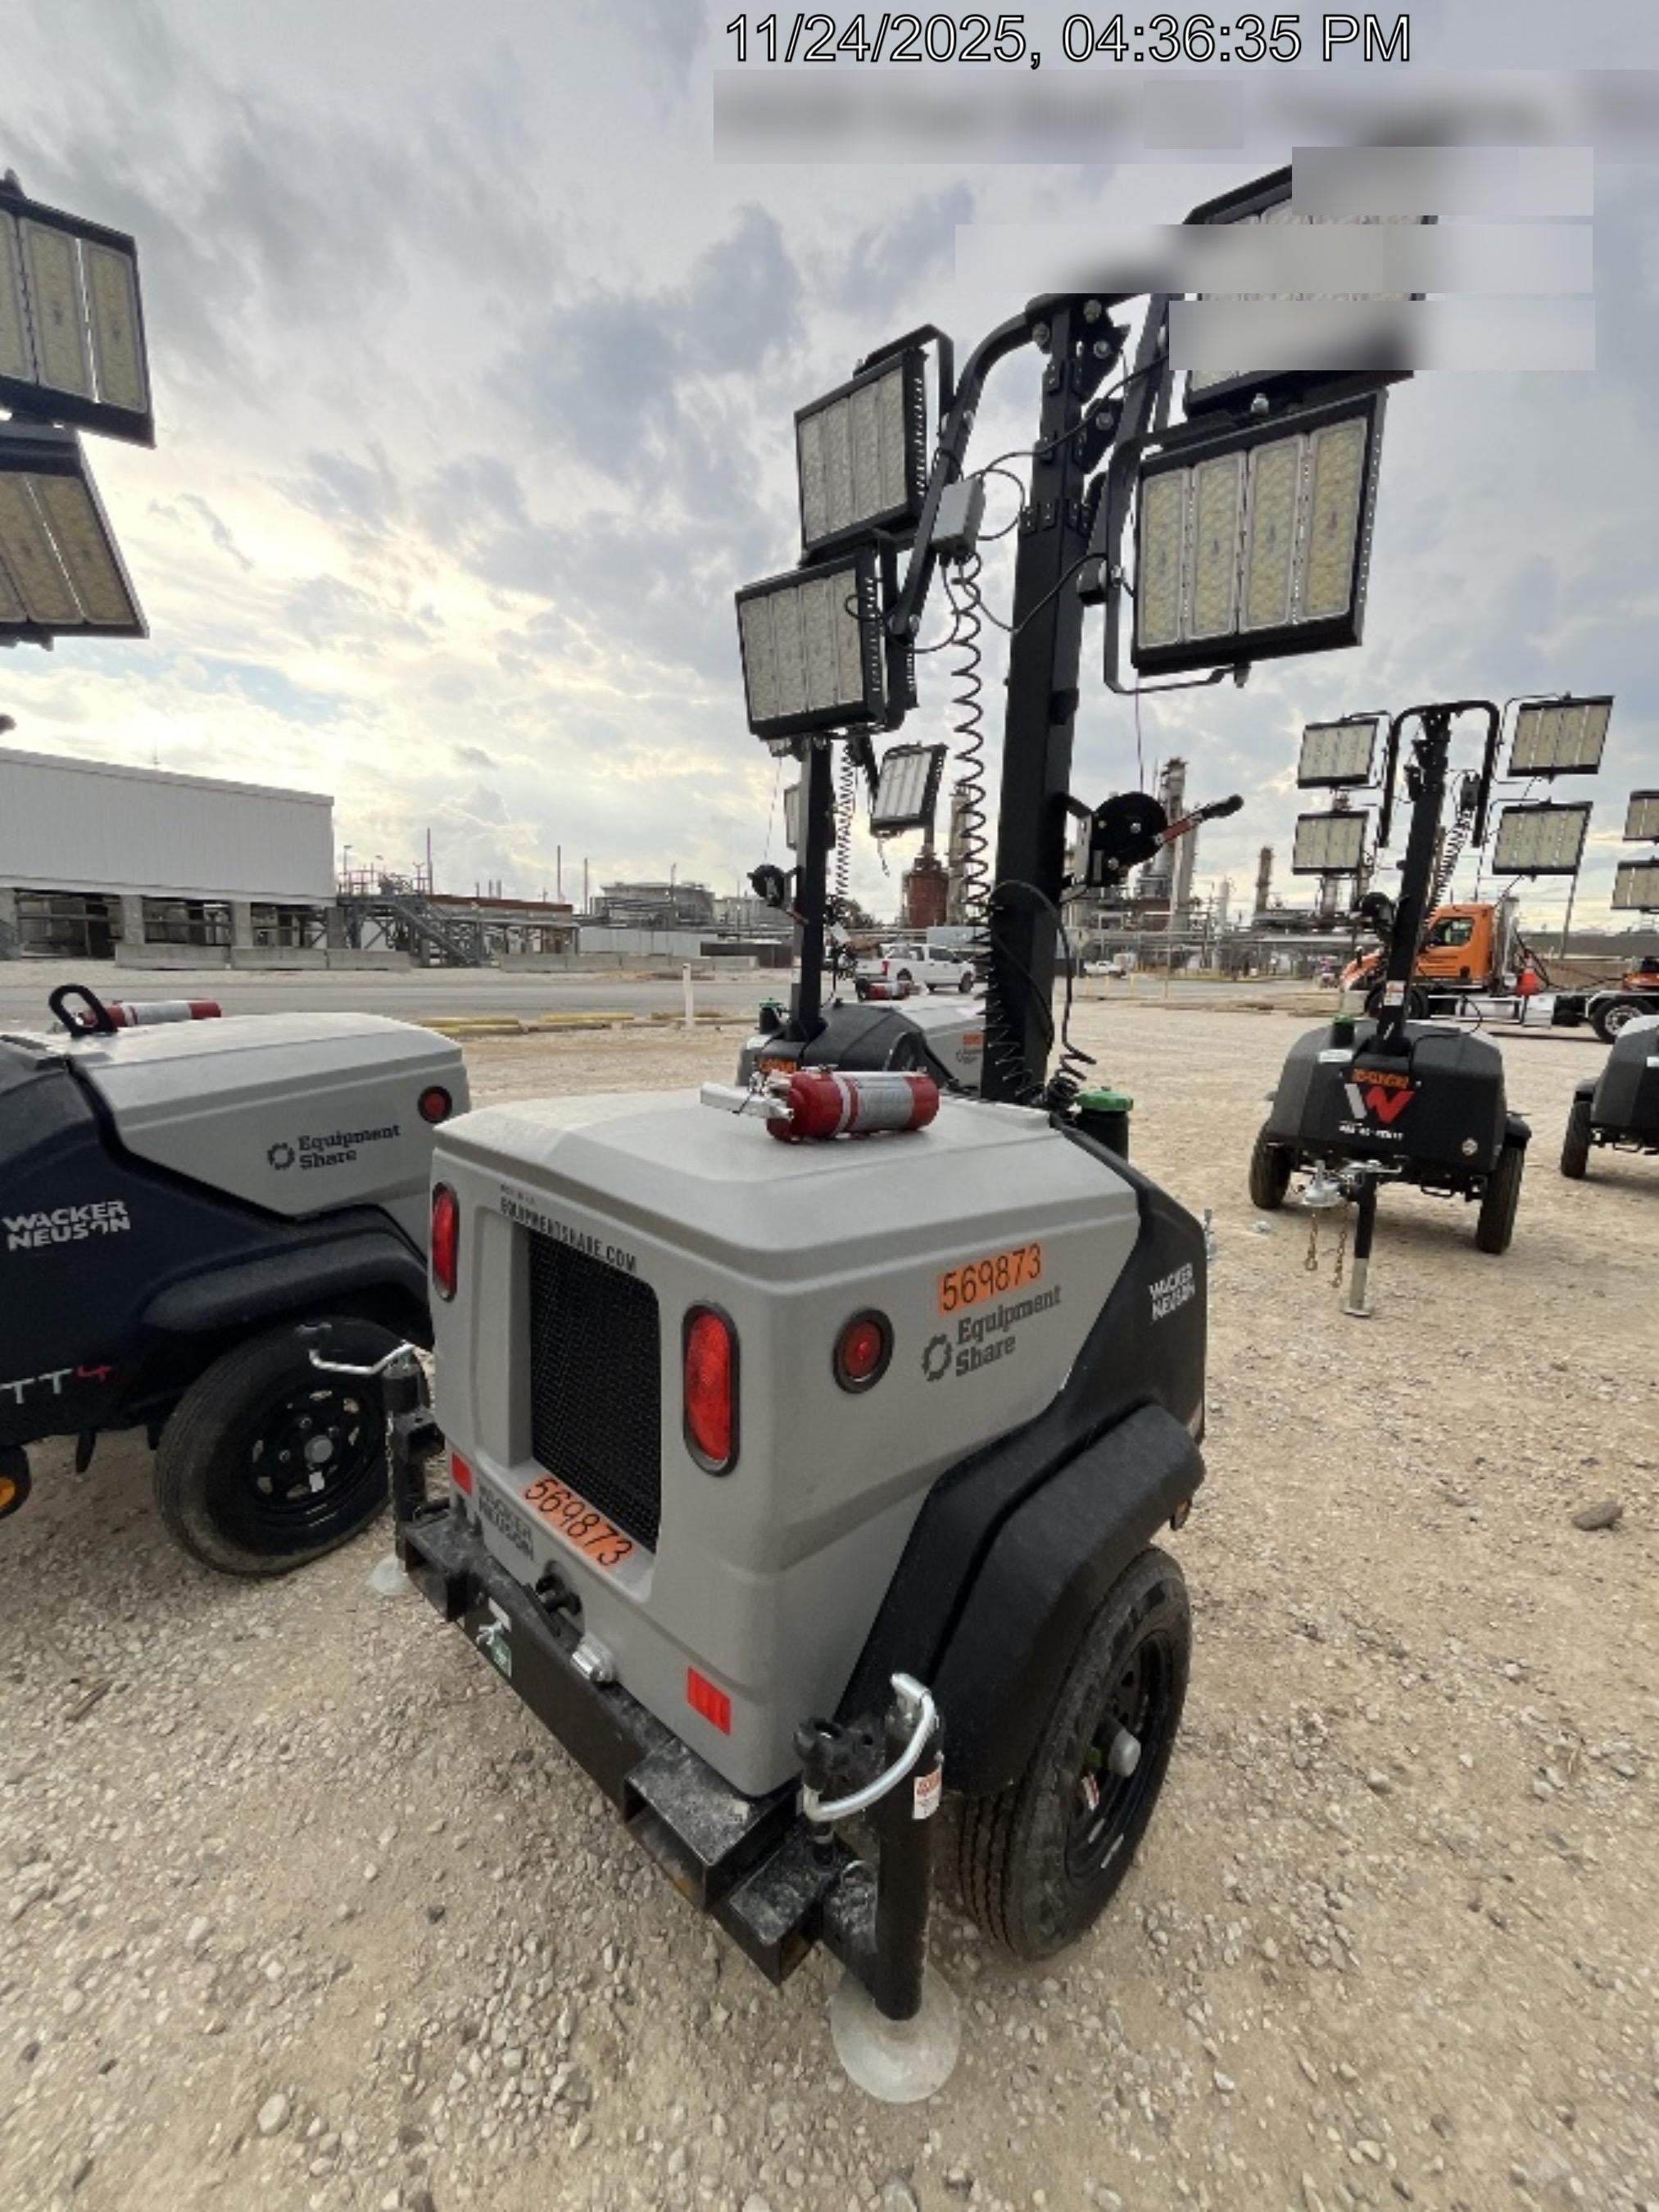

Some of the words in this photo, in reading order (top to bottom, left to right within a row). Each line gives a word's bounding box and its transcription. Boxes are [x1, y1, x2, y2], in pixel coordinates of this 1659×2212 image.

[297, 1125, 400, 1153] Equipment
[299, 1150, 357, 1170] Share
[2, 1199, 129, 1232] WACKER
[942, 1243, 1041, 1312] 569873
[956, 1284, 1062, 1345] Equipment
[954, 1335, 1017, 1377] Share
[524, 1478, 633, 1566] 569873
